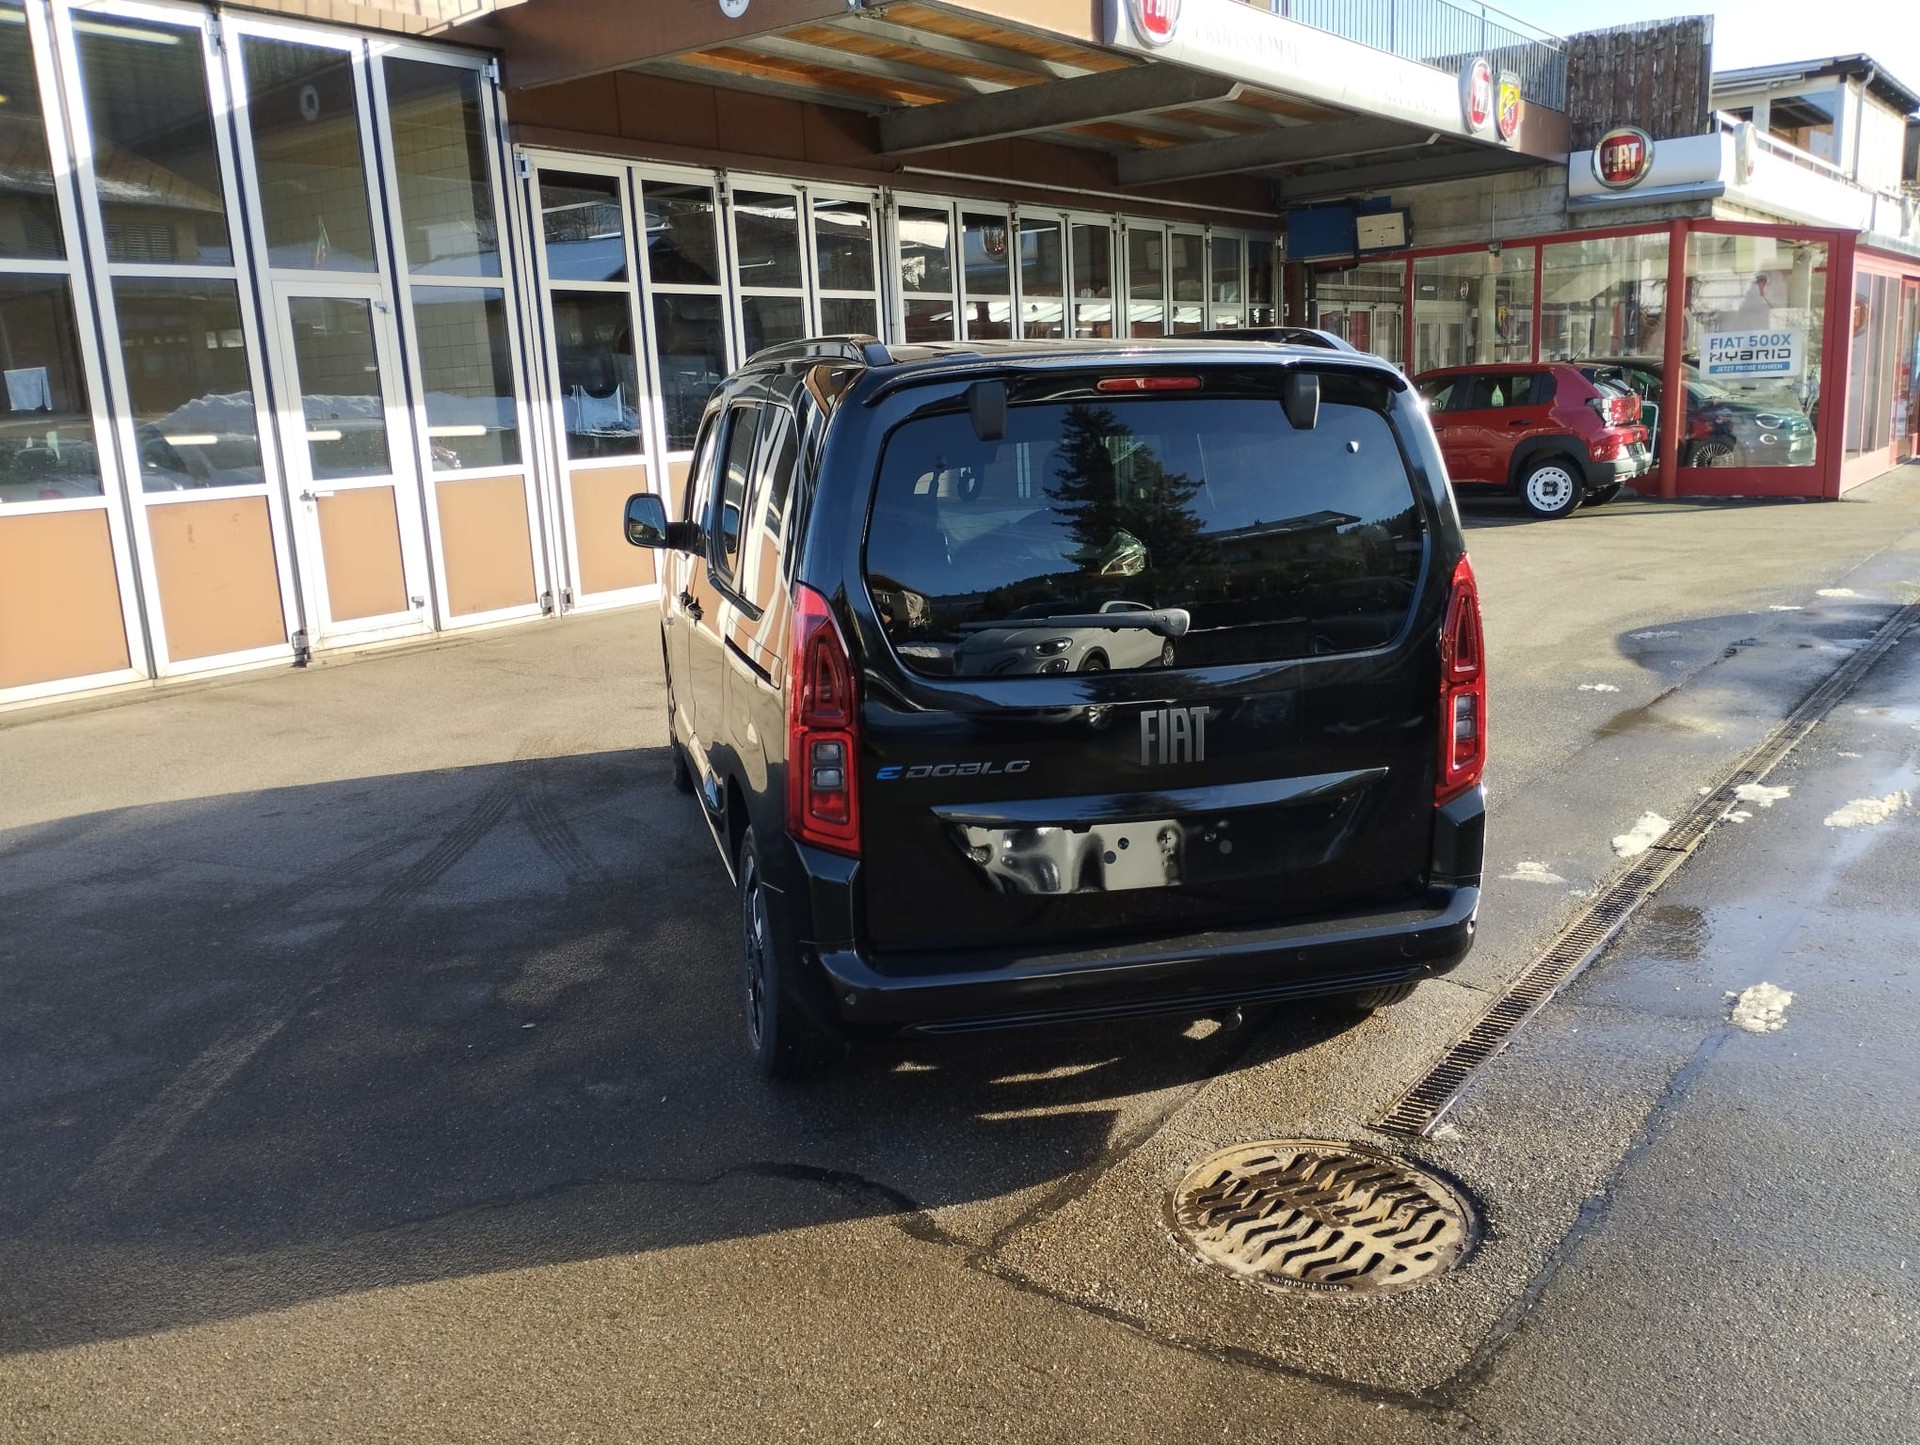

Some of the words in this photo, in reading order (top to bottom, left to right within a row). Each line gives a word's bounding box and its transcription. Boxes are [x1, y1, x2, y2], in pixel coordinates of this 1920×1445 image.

[1604, 142, 1640, 174] FIAT
[1710, 336, 1744, 350] FIAT
[1748, 333, 1791, 348] 500X
[1709, 348, 1791, 363] HYBRID
[1140, 706, 1210, 766] FIAT
